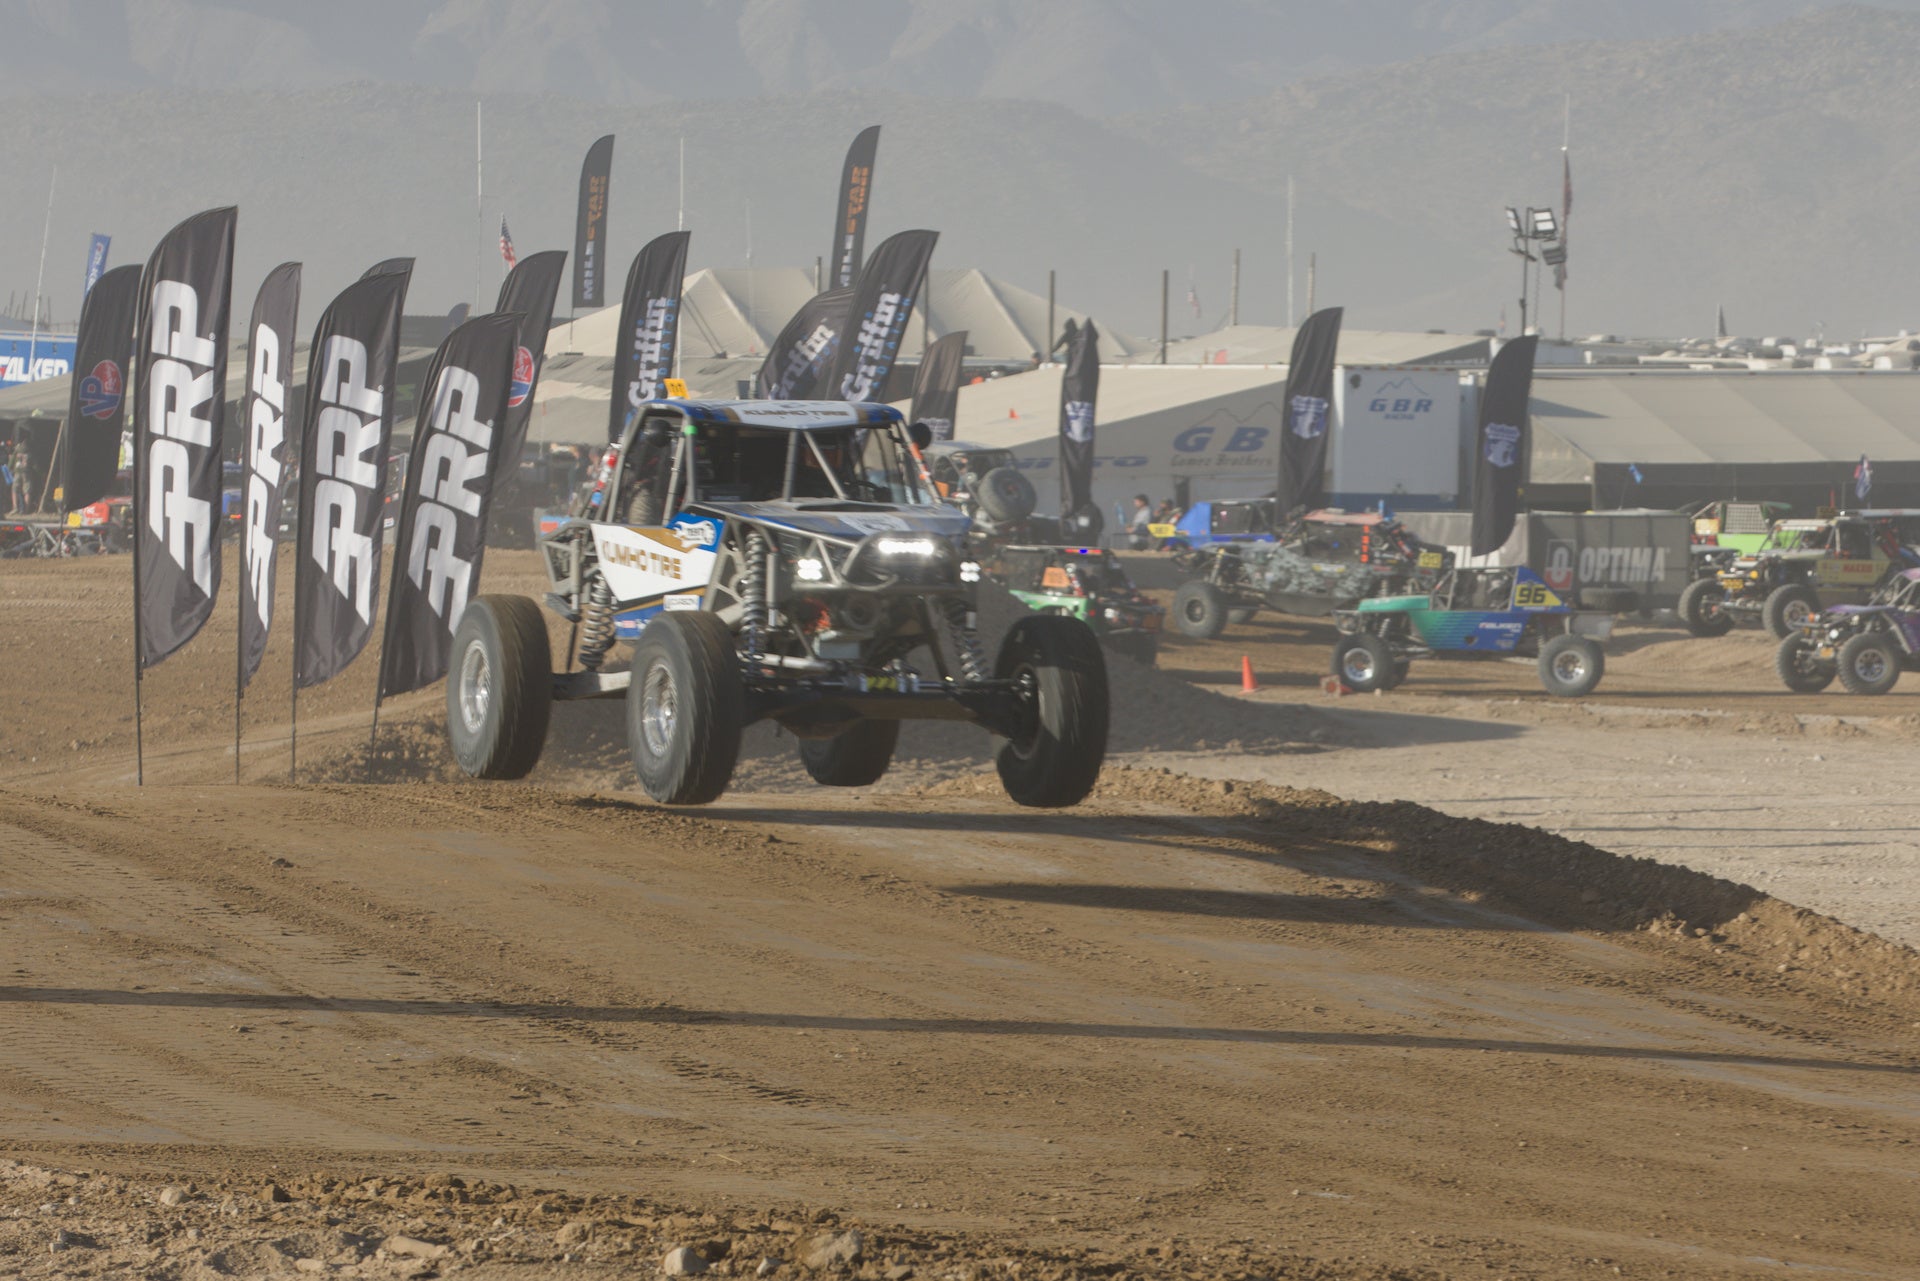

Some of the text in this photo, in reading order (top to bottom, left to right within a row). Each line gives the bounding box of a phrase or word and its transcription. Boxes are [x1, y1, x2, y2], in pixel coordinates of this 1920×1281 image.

[628, 296, 667, 407] Griffin
[840, 292, 901, 401] Griffin
[868, 297, 911, 391] ADIATOR
[149, 280, 215, 599] PRP
[743, 409, 807, 417] KUMHO
[246, 323, 285, 632] PRP
[312, 335, 384, 626] PRP
[408, 365, 493, 638] PRP
[1516, 587, 1547, 604] 96
[1578, 546, 1665, 583] OPTIMA
